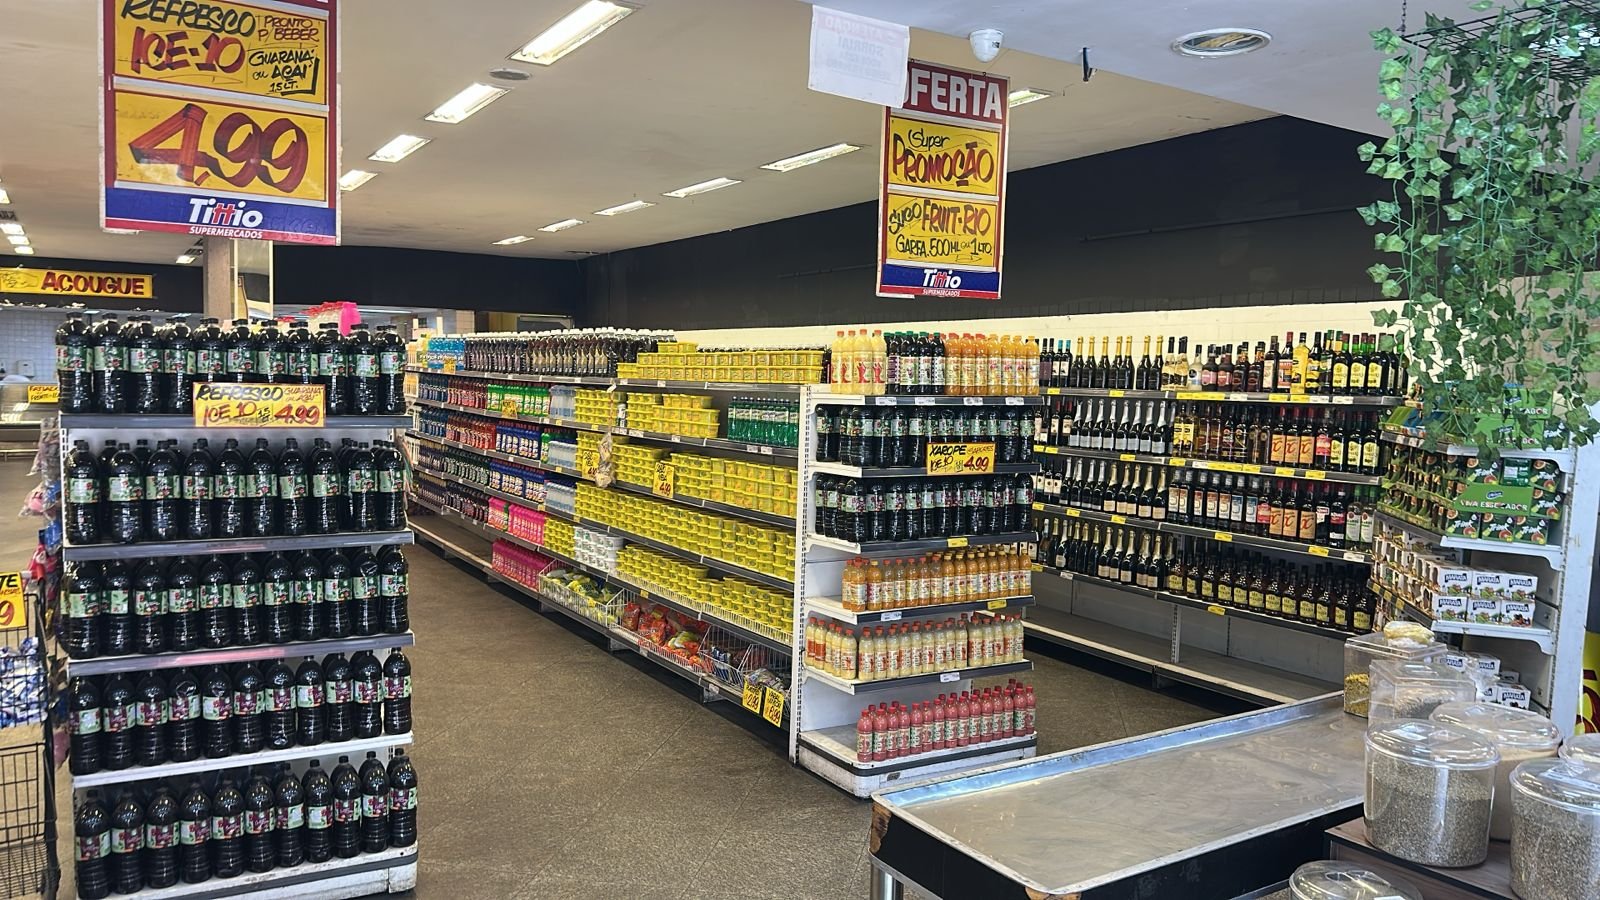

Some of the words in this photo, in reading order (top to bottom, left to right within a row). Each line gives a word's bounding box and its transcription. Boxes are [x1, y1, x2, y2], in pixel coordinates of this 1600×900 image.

[121, 0, 256, 37] REFRESCO
[264, 15, 313, 28] PRONTO
[274, 28, 319, 42] BEBER
[131, 26, 246, 74] ICE-10
[903, 67, 1002, 120] FERTA
[893, 133, 994, 187] PROMOÇÃO
[189, 198, 263, 228] Tittio
[189, 225, 263, 240] SUPERMERCADOS
[922, 269, 961, 289] Tittio
[922, 288, 960, 297] SUPERMERCADOS
[196, 385, 284, 401] REFRESCO
[930, 445, 967, 456] XAROPE
